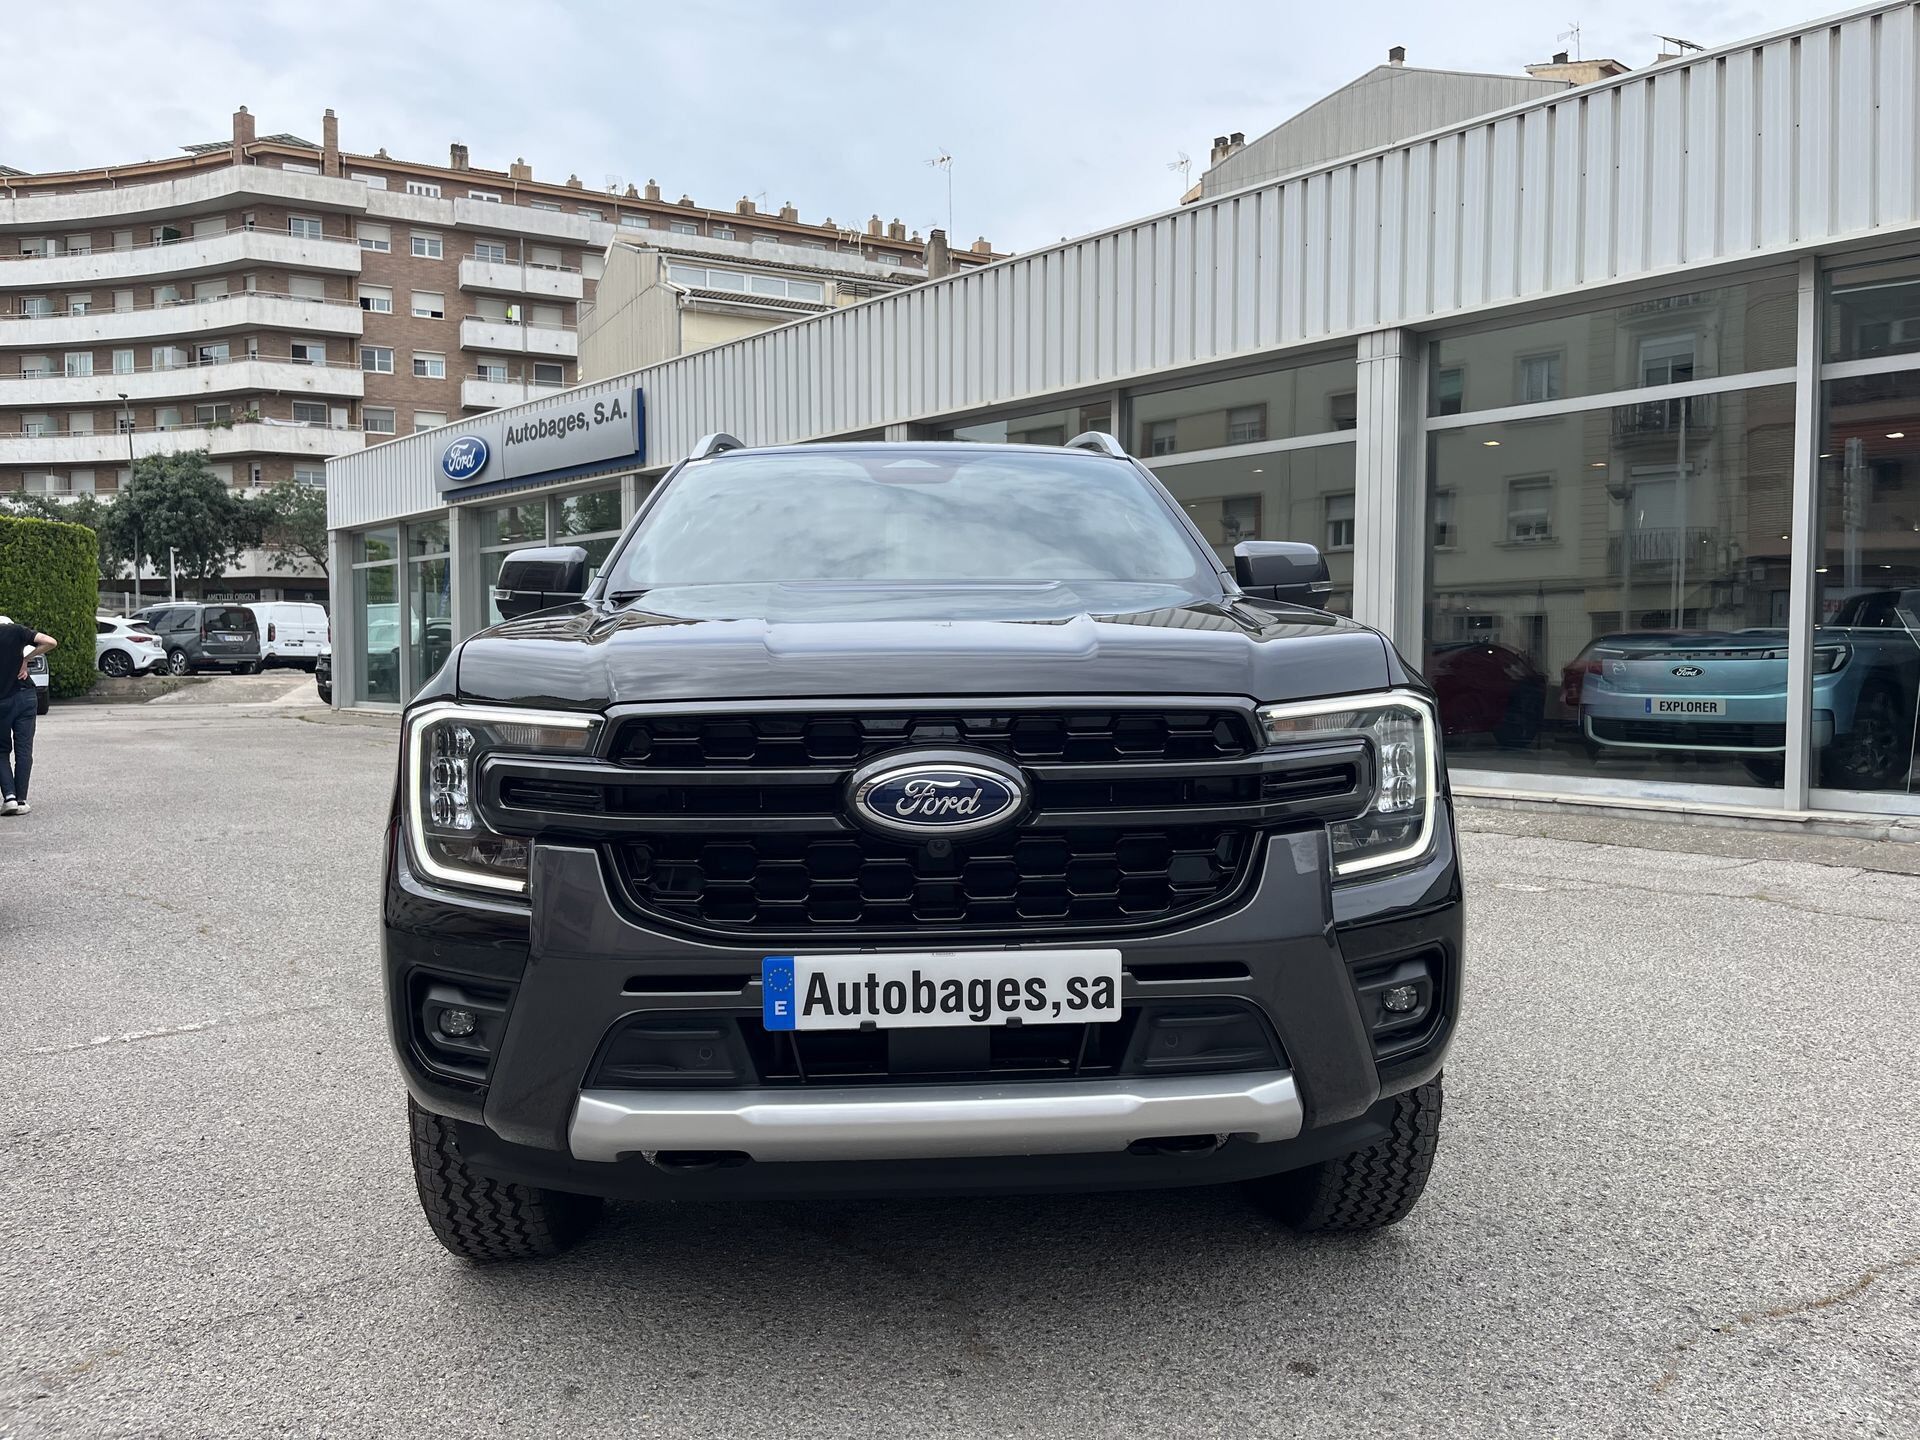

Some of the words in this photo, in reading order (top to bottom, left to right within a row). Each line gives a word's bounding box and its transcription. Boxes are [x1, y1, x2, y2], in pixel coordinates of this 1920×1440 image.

[505, 412, 589, 446] Autobages,
[594, 398, 627, 425] S.A.
[448, 442, 476, 472] Ford
[1677, 667, 1697, 676] Ford
[1659, 701, 1717, 712] EXPLORER
[896, 779, 983, 816] Ford
[774, 1001, 787, 1015] E
[802, 970, 1115, 1022] Autobages,sa
